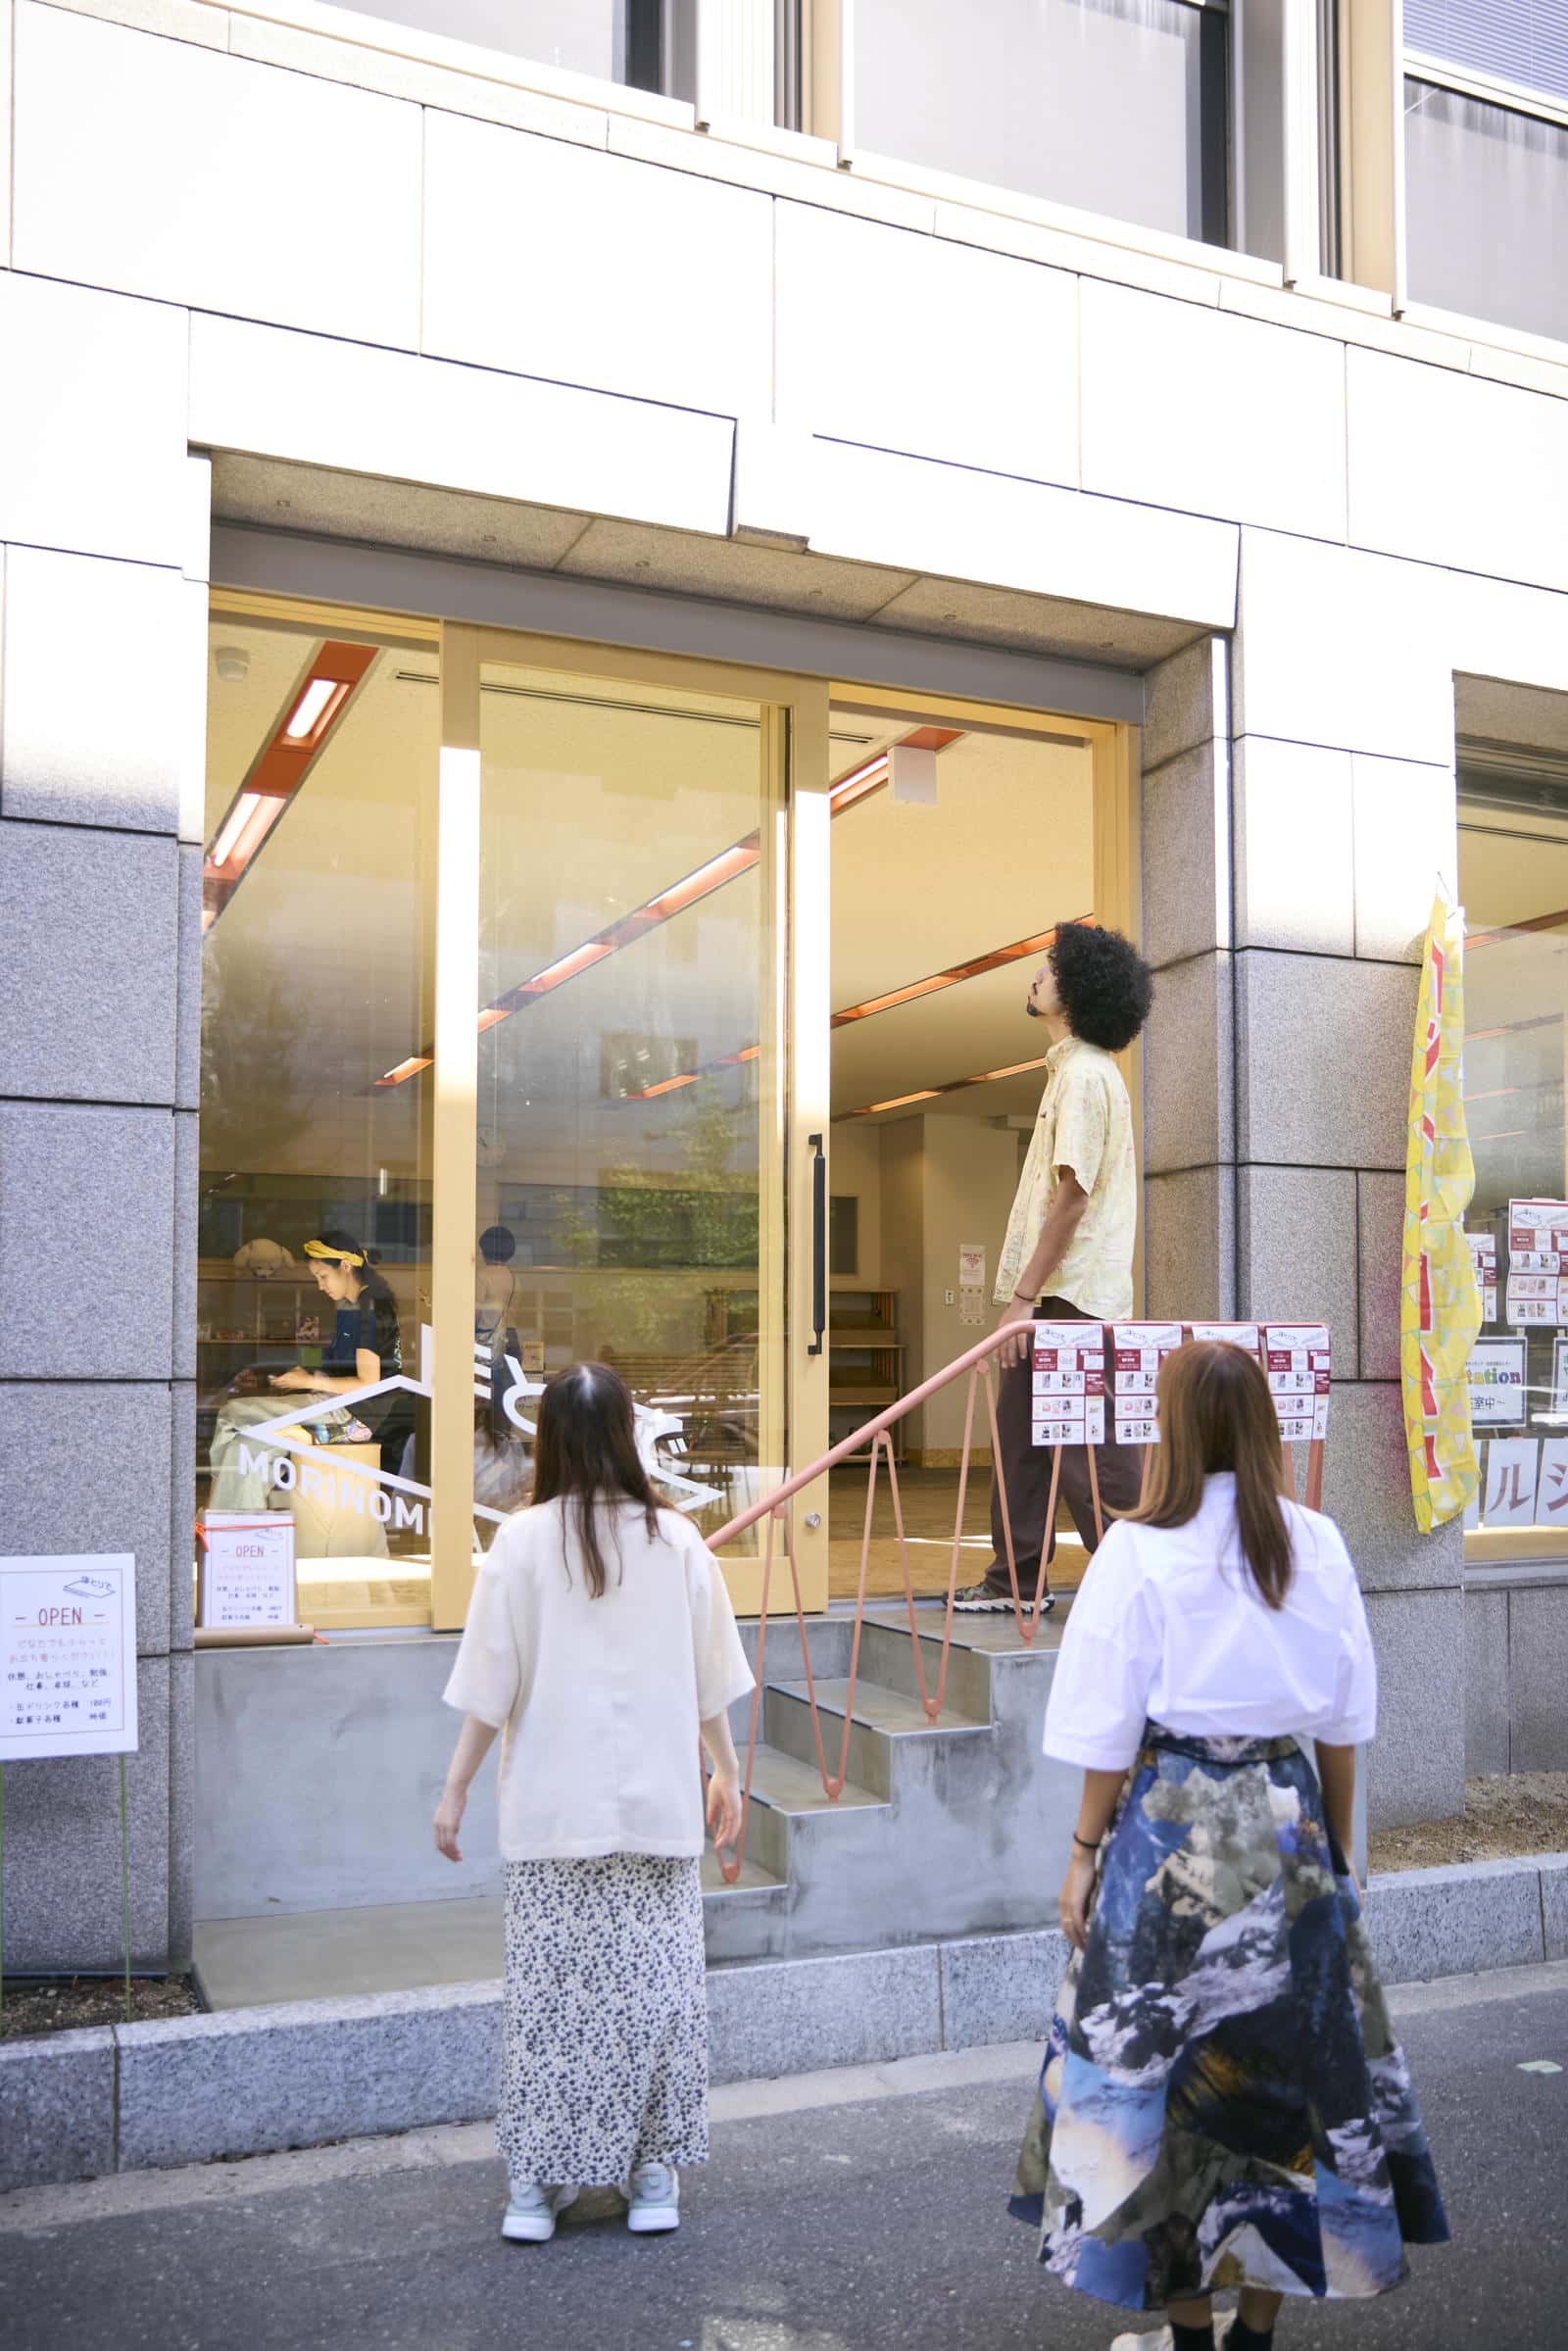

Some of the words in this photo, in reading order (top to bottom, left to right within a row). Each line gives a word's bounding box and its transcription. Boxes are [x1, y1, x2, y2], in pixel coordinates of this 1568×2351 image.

[1466, 1368, 1521, 1384] tation
[235, 1545, 265, 1558] OPEN
[38, 1607, 82, 1626] OPEN
